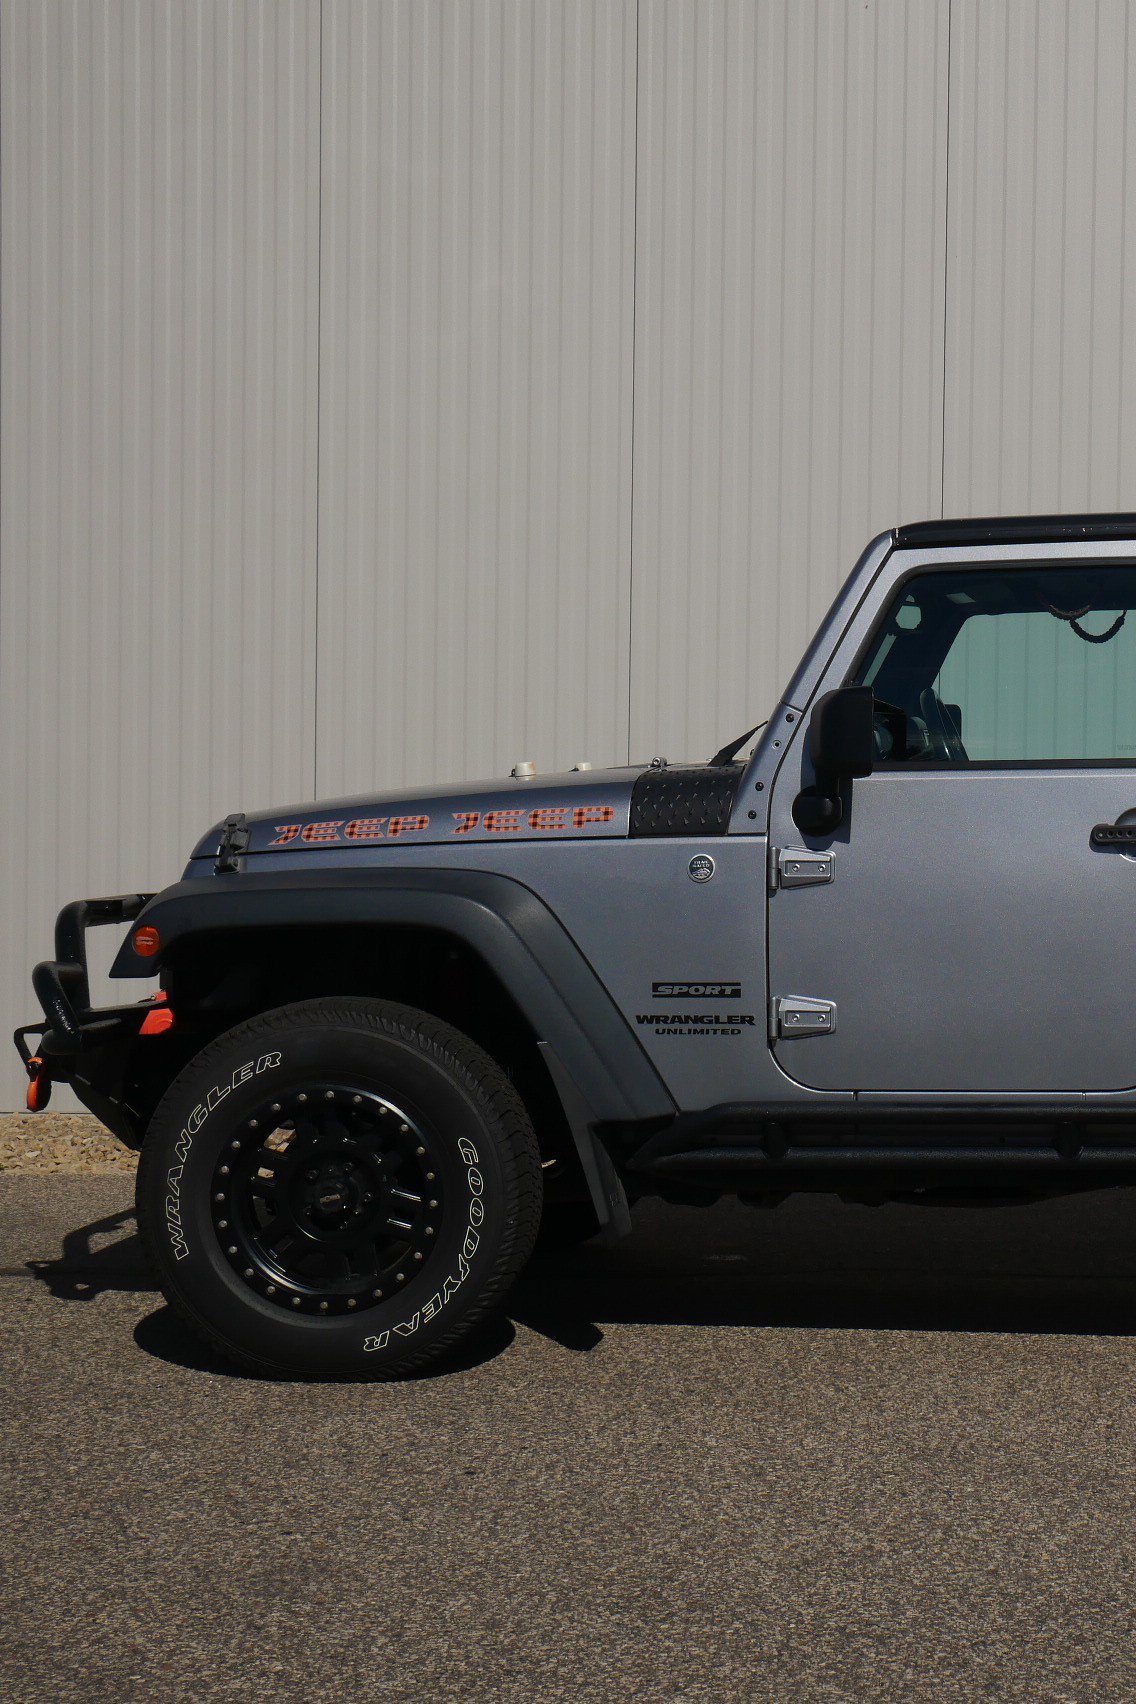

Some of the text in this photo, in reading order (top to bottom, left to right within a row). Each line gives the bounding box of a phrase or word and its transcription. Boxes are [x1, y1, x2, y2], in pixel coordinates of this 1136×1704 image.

[268, 805, 617, 846] JEEP JEEP
[656, 985, 741, 995] SPORT
[635, 1014, 756, 1026] WRANGLER
[655, 1028, 742, 1036] UNLIMITED
[165, 1051, 282, 1261] WRANGLER
[363, 1137, 484, 1353] GOODYEAR
